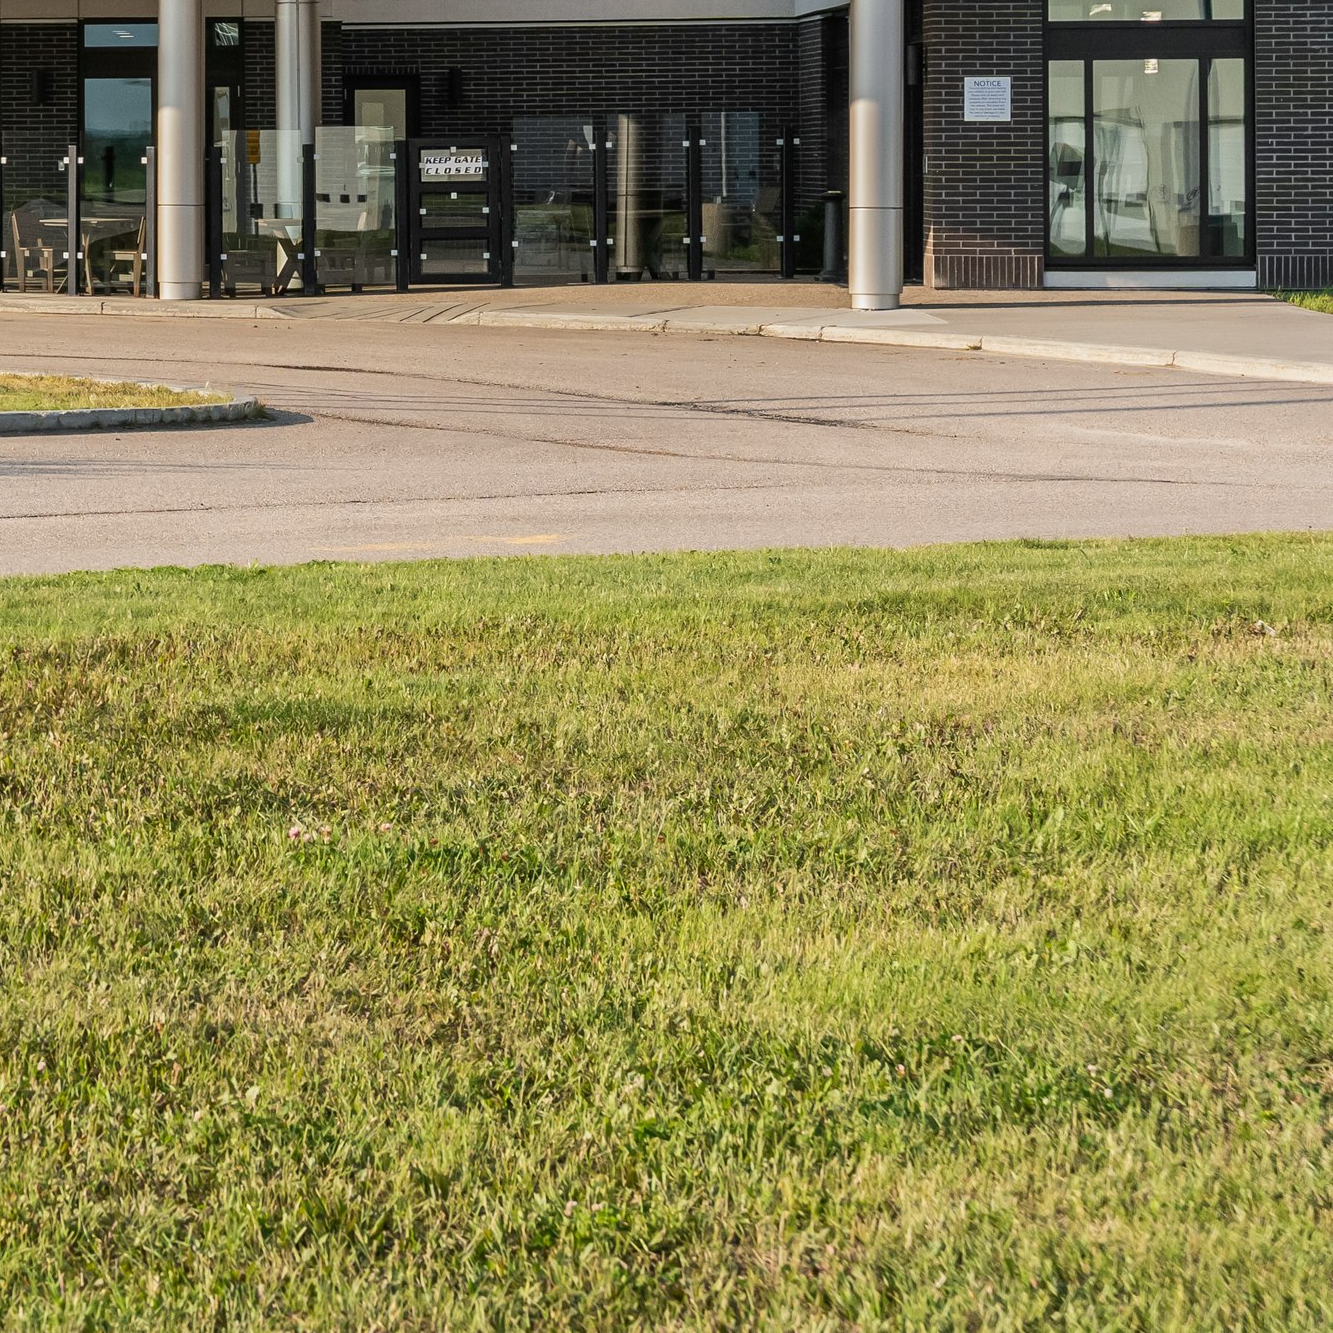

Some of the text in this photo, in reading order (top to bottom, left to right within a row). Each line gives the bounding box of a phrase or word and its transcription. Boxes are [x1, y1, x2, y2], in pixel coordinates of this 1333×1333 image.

[425, 155, 482, 165] KEEP GATE
[425, 166, 482, 175] CLOSED
